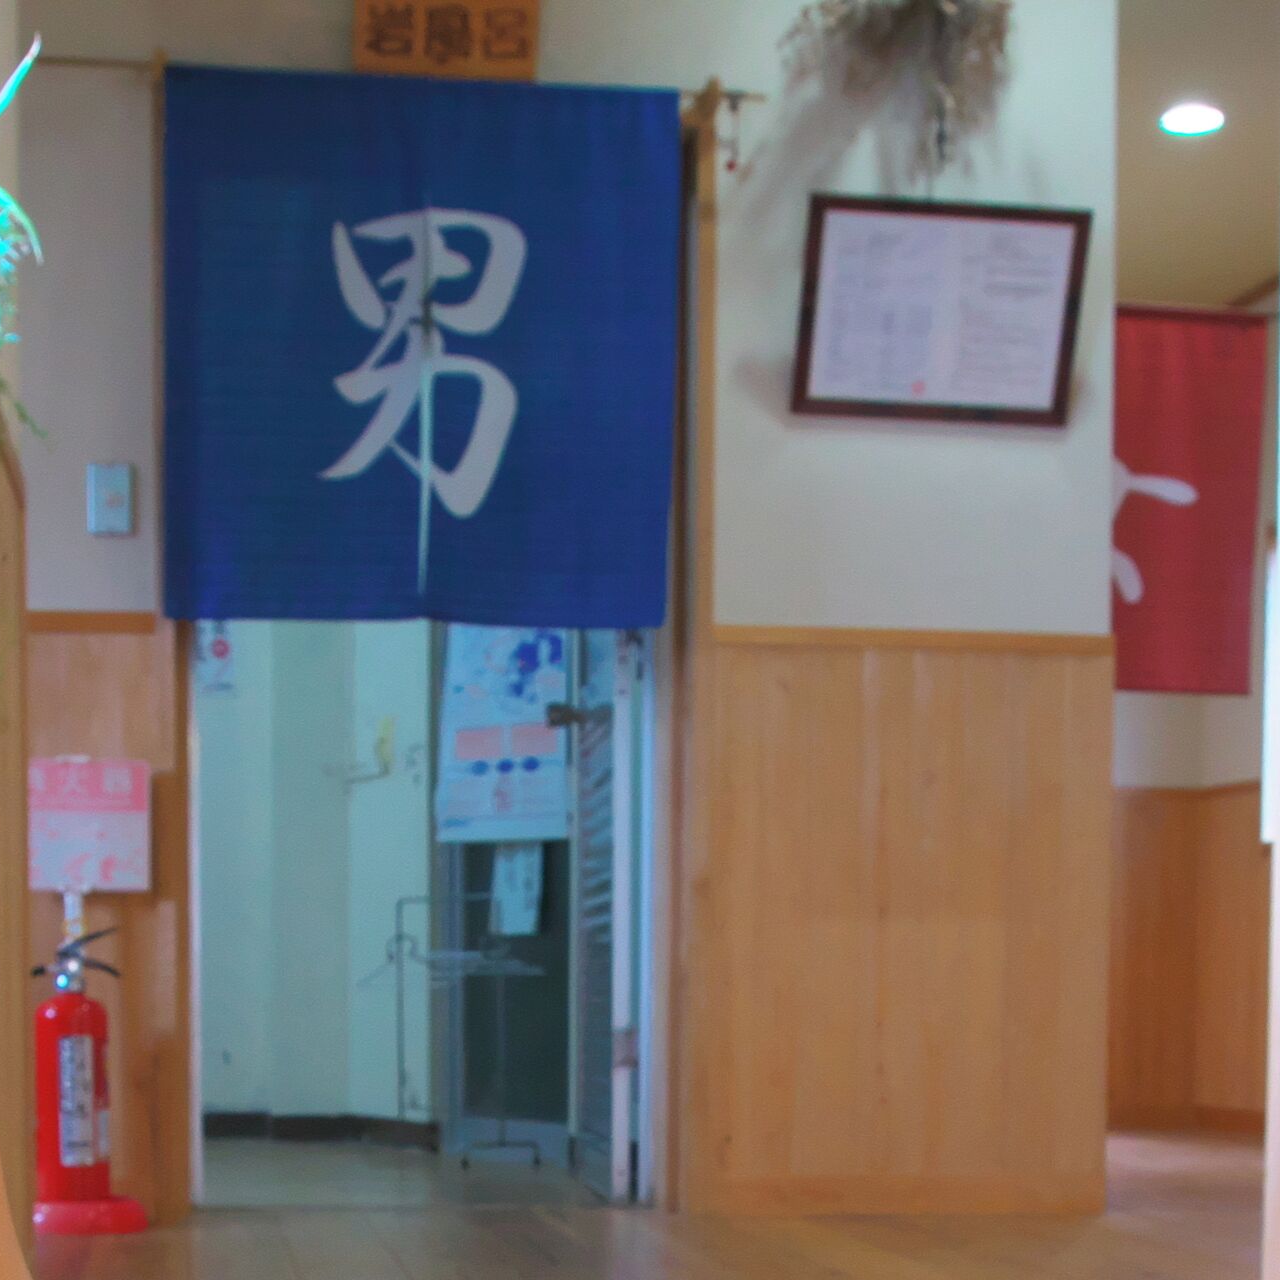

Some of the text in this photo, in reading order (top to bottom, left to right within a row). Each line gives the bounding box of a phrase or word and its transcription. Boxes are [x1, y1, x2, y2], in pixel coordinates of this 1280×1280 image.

[367, 3, 529, 64] 岩風呂
[320, 207, 527, 518] 男
